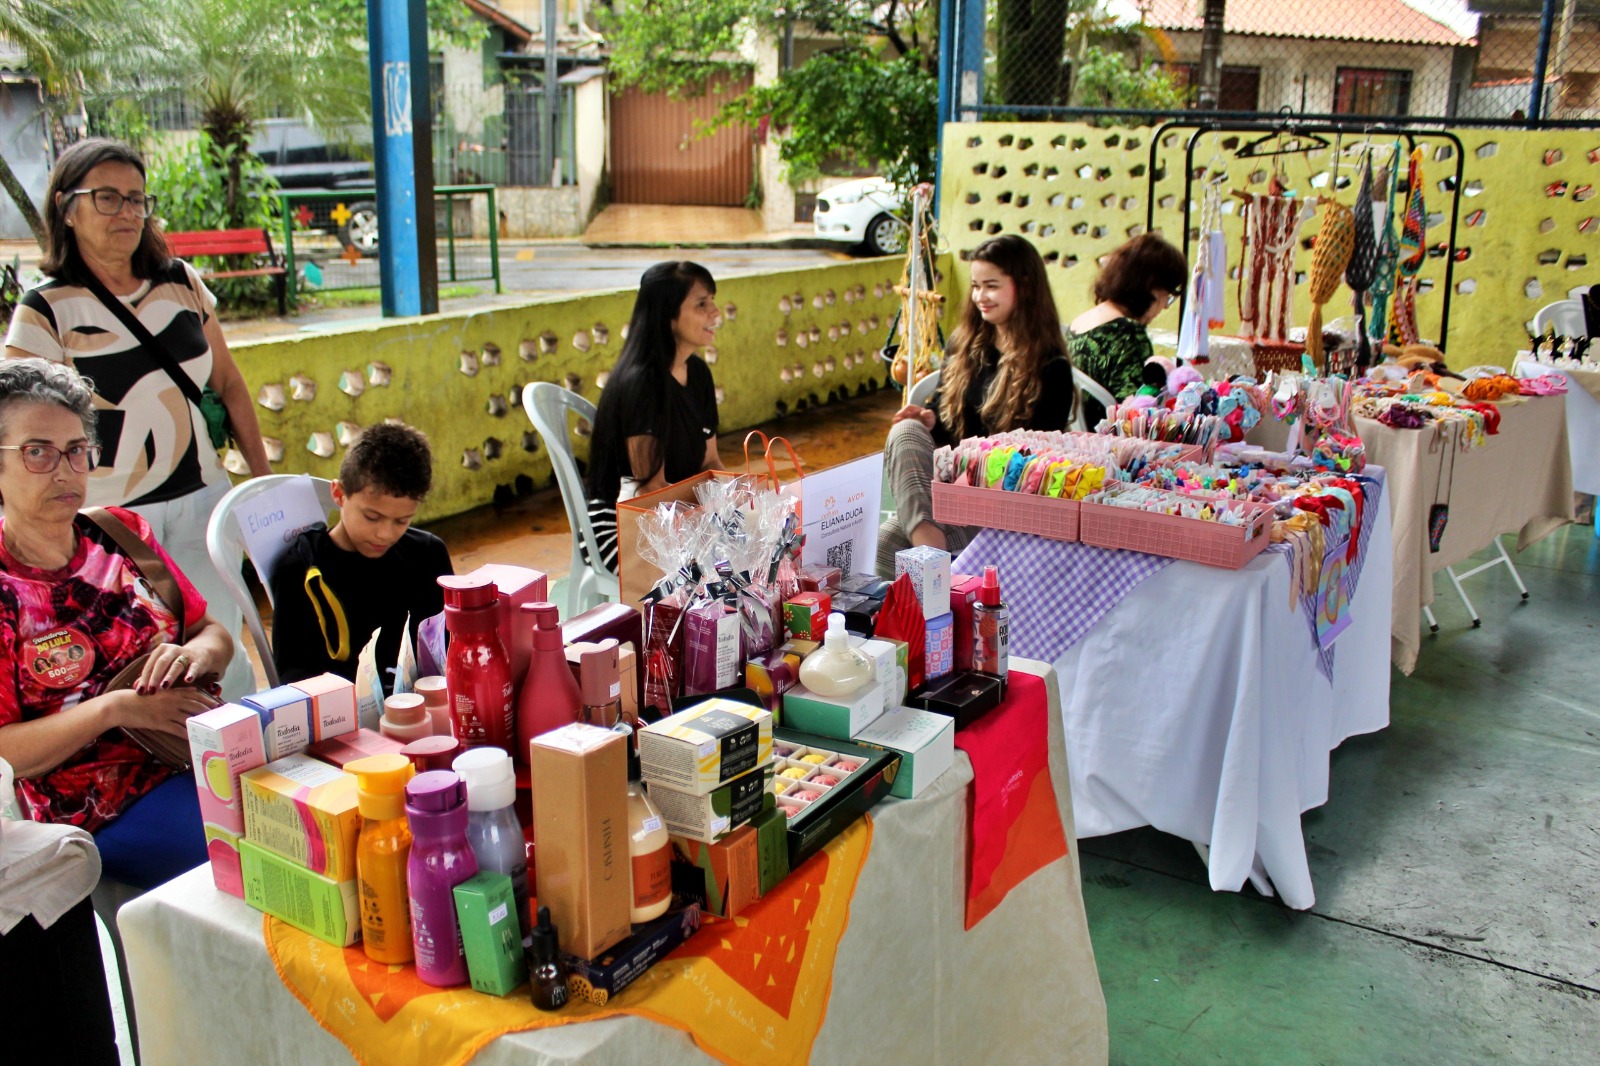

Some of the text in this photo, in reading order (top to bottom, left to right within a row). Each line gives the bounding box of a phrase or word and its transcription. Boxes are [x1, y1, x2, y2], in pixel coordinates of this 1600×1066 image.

[847, 492, 865, 503] AVON
[247, 509, 285, 534] Eliana
[821, 506, 863, 530] ELIANA DUCA
[49, 635, 72, 649] LULA
[48, 666, 67, 679] 500
[323, 715, 346, 728] Tododia
[277, 725, 300, 738] Tododia
[229, 747, 253, 761] Tododia
